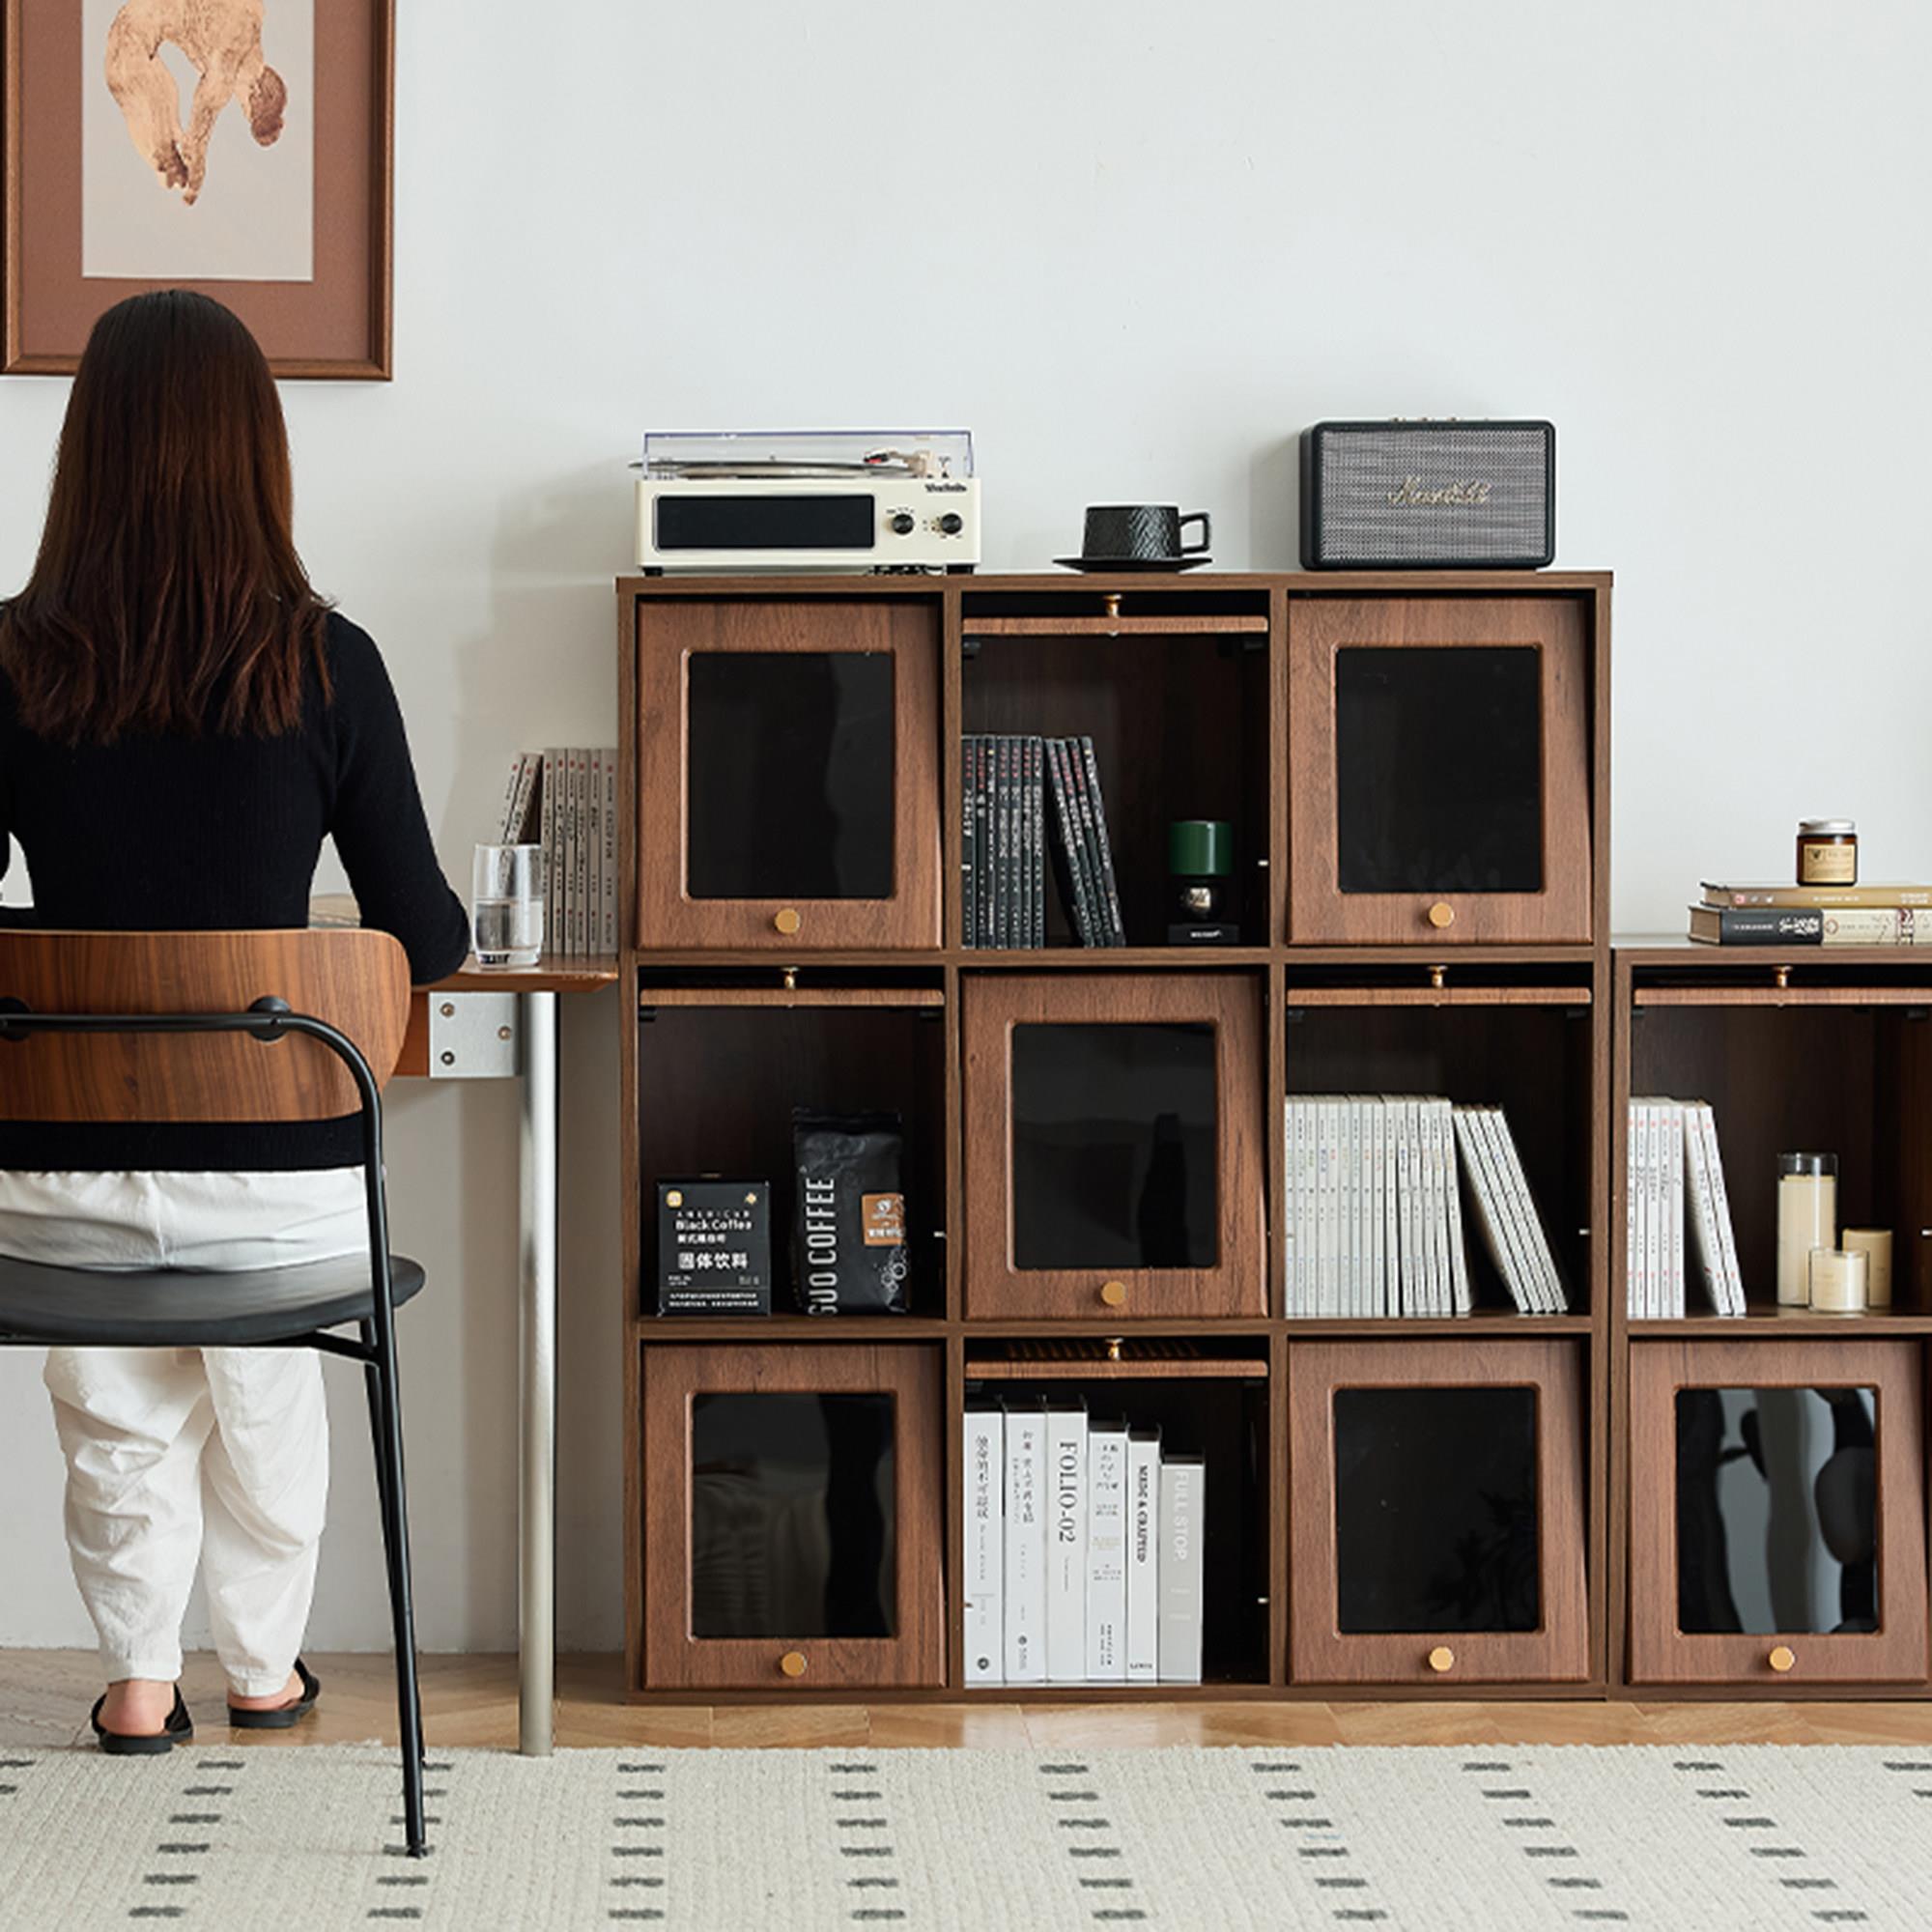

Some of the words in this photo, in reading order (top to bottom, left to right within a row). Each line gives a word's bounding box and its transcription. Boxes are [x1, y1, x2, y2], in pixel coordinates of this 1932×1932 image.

[806, 1178, 837, 1264] COFFEE
[1058, 1441, 1078, 1543] FOLIO-02
[1174, 1470, 1190, 1513] FULL
